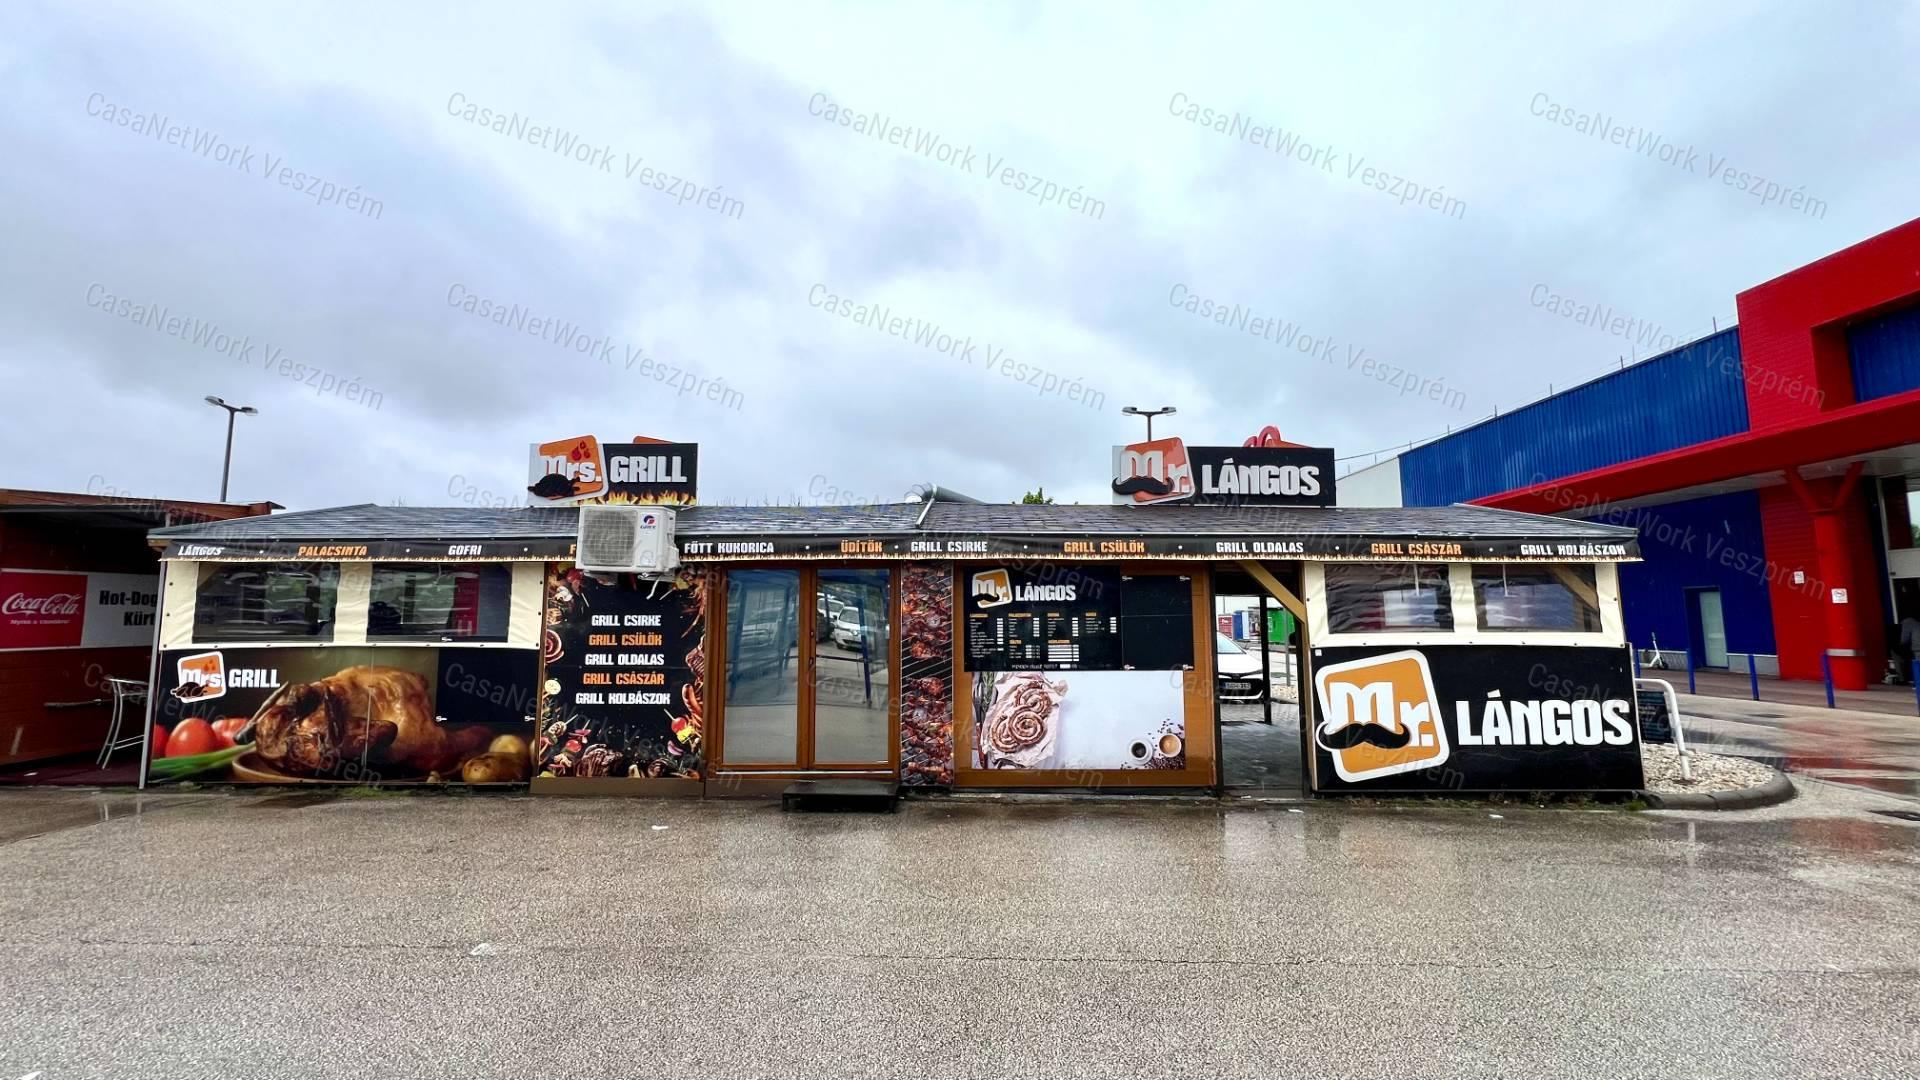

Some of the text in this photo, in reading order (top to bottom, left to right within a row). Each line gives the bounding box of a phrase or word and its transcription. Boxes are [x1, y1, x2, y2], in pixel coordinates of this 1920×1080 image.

[610, 456, 687, 483] GRILL
[1202, 458, 1320, 496] LÁNGOS
[298, 545, 367, 557] PALACSINTA
[448, 545, 482, 556] GOFRI
[717, 542, 774, 554] KUKORICA
[911, 541, 988, 553] GRILL CSIRKE
[1063, 541, 1096, 553] GRILL
[1216, 541, 1304, 554] GRILL OLDALAS
[1371, 542, 1462, 555] GRILL CSÁSZÁR
[1520, 543, 1626, 556] GRILL KOLBÁSZOK
[1015, 582, 1077, 601] LÁNGOS
[1, 592, 82, 615] Coca-Cola
[591, 615, 661, 627] GRILL CSIRKE
[589, 631, 662, 646] GRILL CSÜLÖK
[585, 653, 665, 666] GRILL OLDALAS
[229, 669, 281, 688] GRILL
[583, 671, 665, 685] GRILL CSÁSZÁR
[575, 690, 670, 705] GRILL KOLBÁSZOK
[1324, 681, 1434, 748] Mr.
[1455, 689, 1634, 746] LÁNGOS
